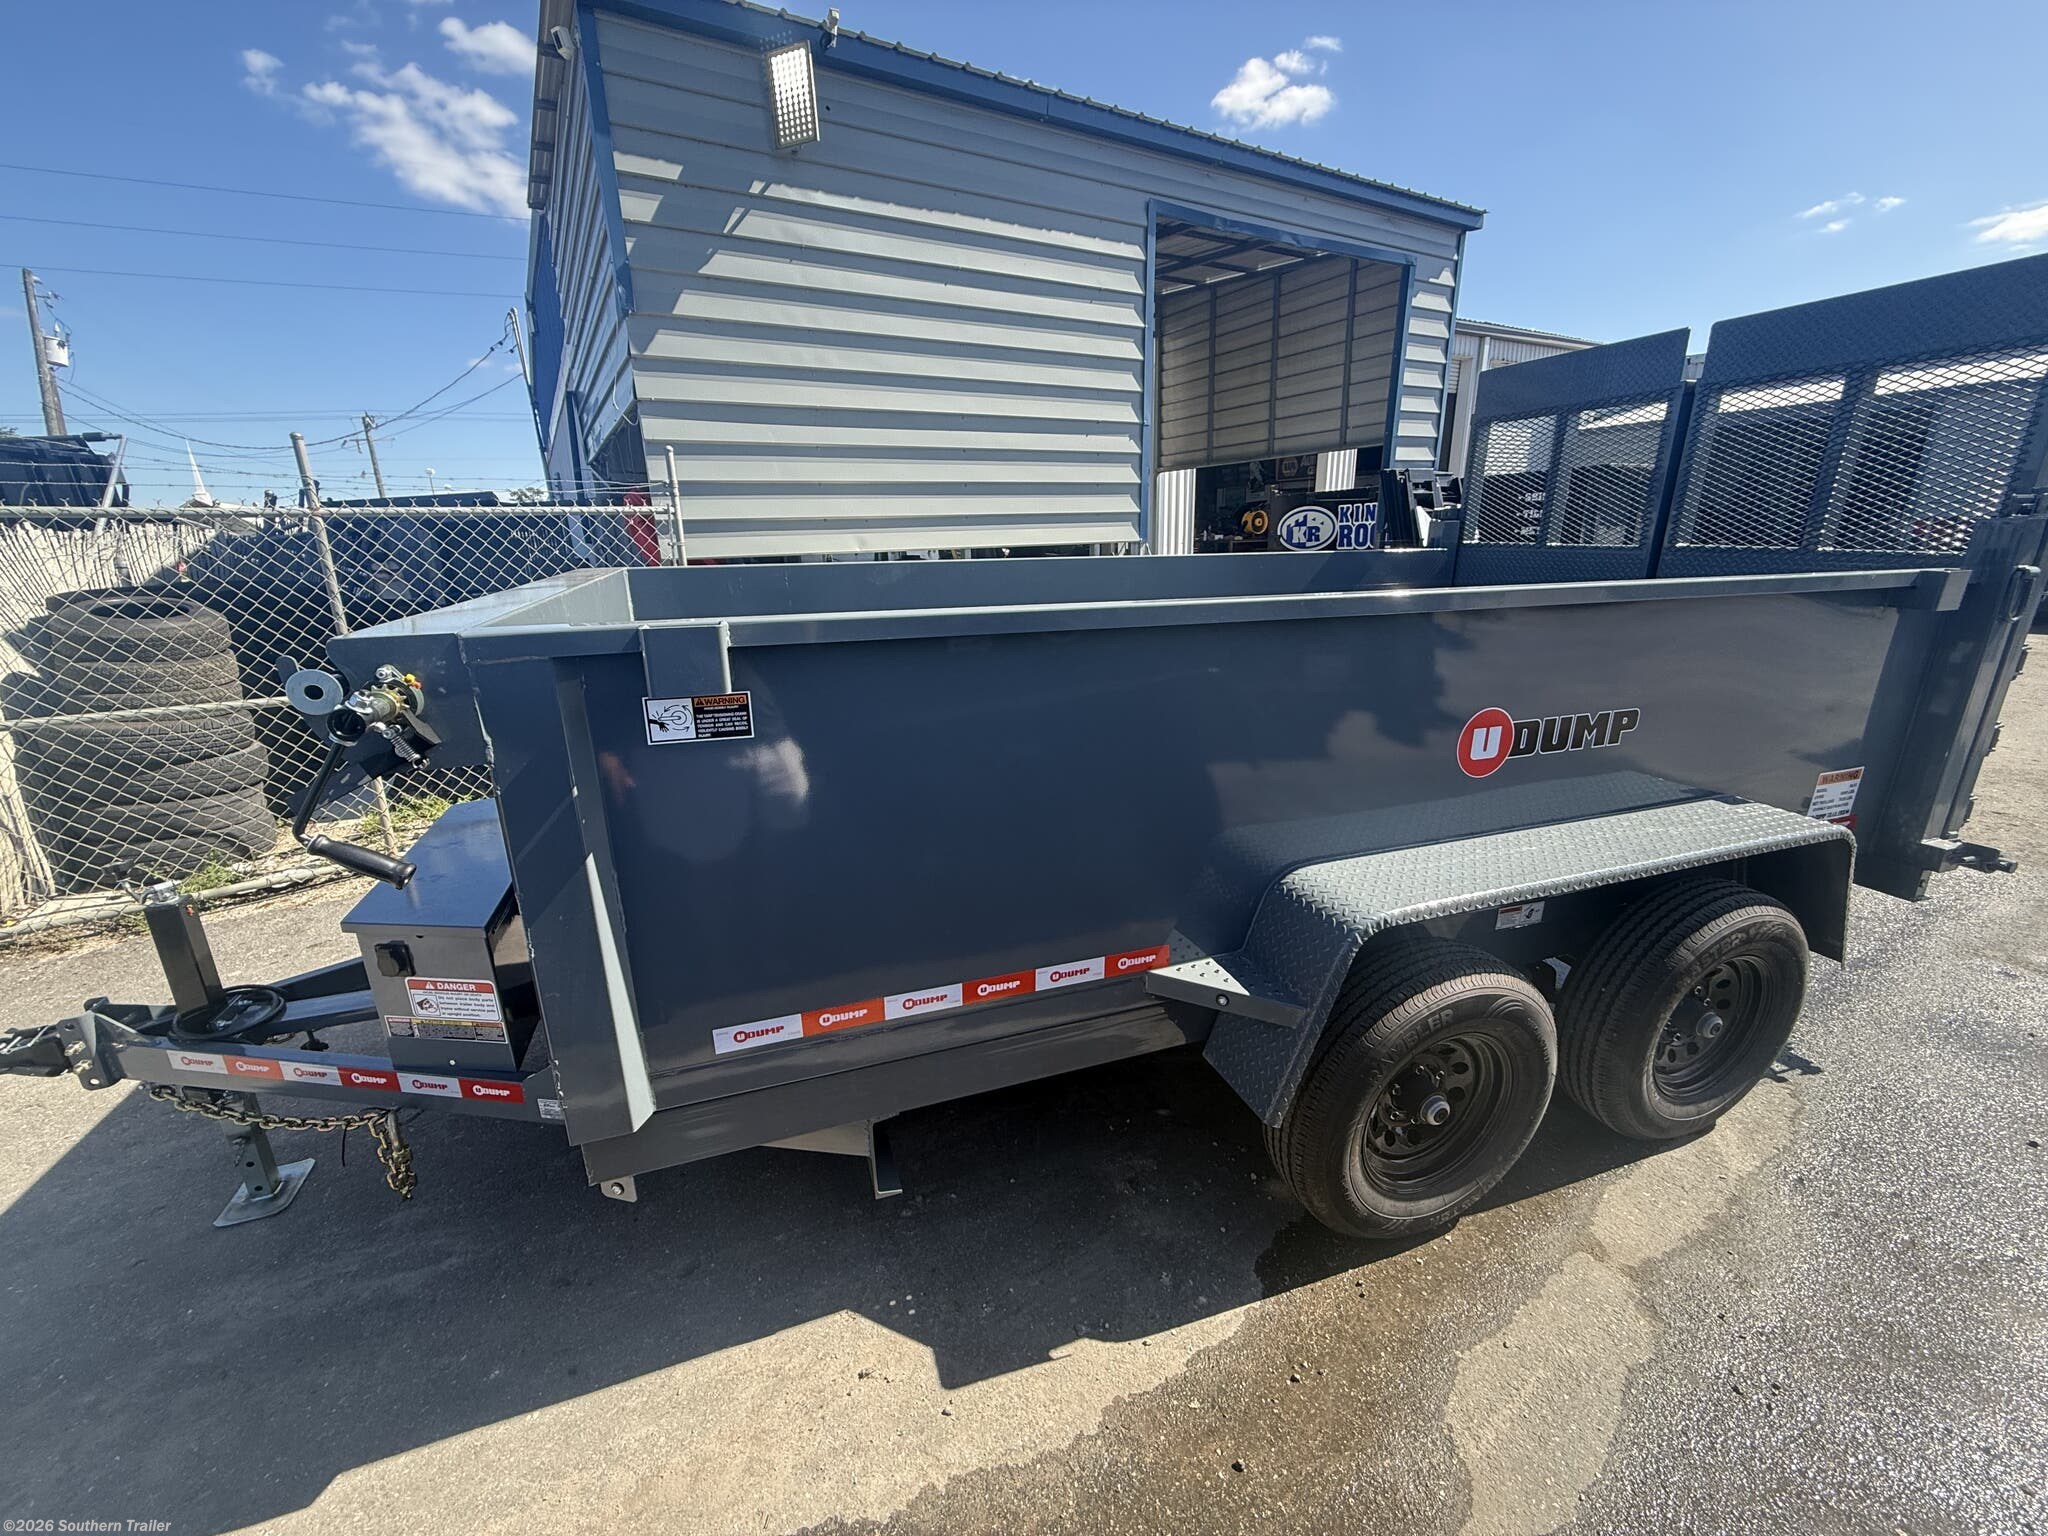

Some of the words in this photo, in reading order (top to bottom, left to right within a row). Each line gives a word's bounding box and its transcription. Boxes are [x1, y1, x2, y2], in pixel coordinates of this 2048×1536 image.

[1292, 526, 1320, 543] KR
[704, 697, 745, 705] WARNING
[1463, 707, 1640, 770] UDUMP
[1117, 954, 1156, 970] UDUMP
[1049, 967, 1090, 983] UDUMP
[437, 983, 476, 991] DANGER
[977, 980, 1020, 996] UDUMP
[902, 993, 948, 1010] UDUMP
[818, 1008, 868, 1027] UDUMP
[733, 1025, 784, 1044] UDUMP
[235, 1061, 270, 1072] UDUMP
[351, 1072, 387, 1084] UDUMP
[412, 1079, 448, 1090] UDUMP
[472, 1084, 510, 1097] UDUMP
